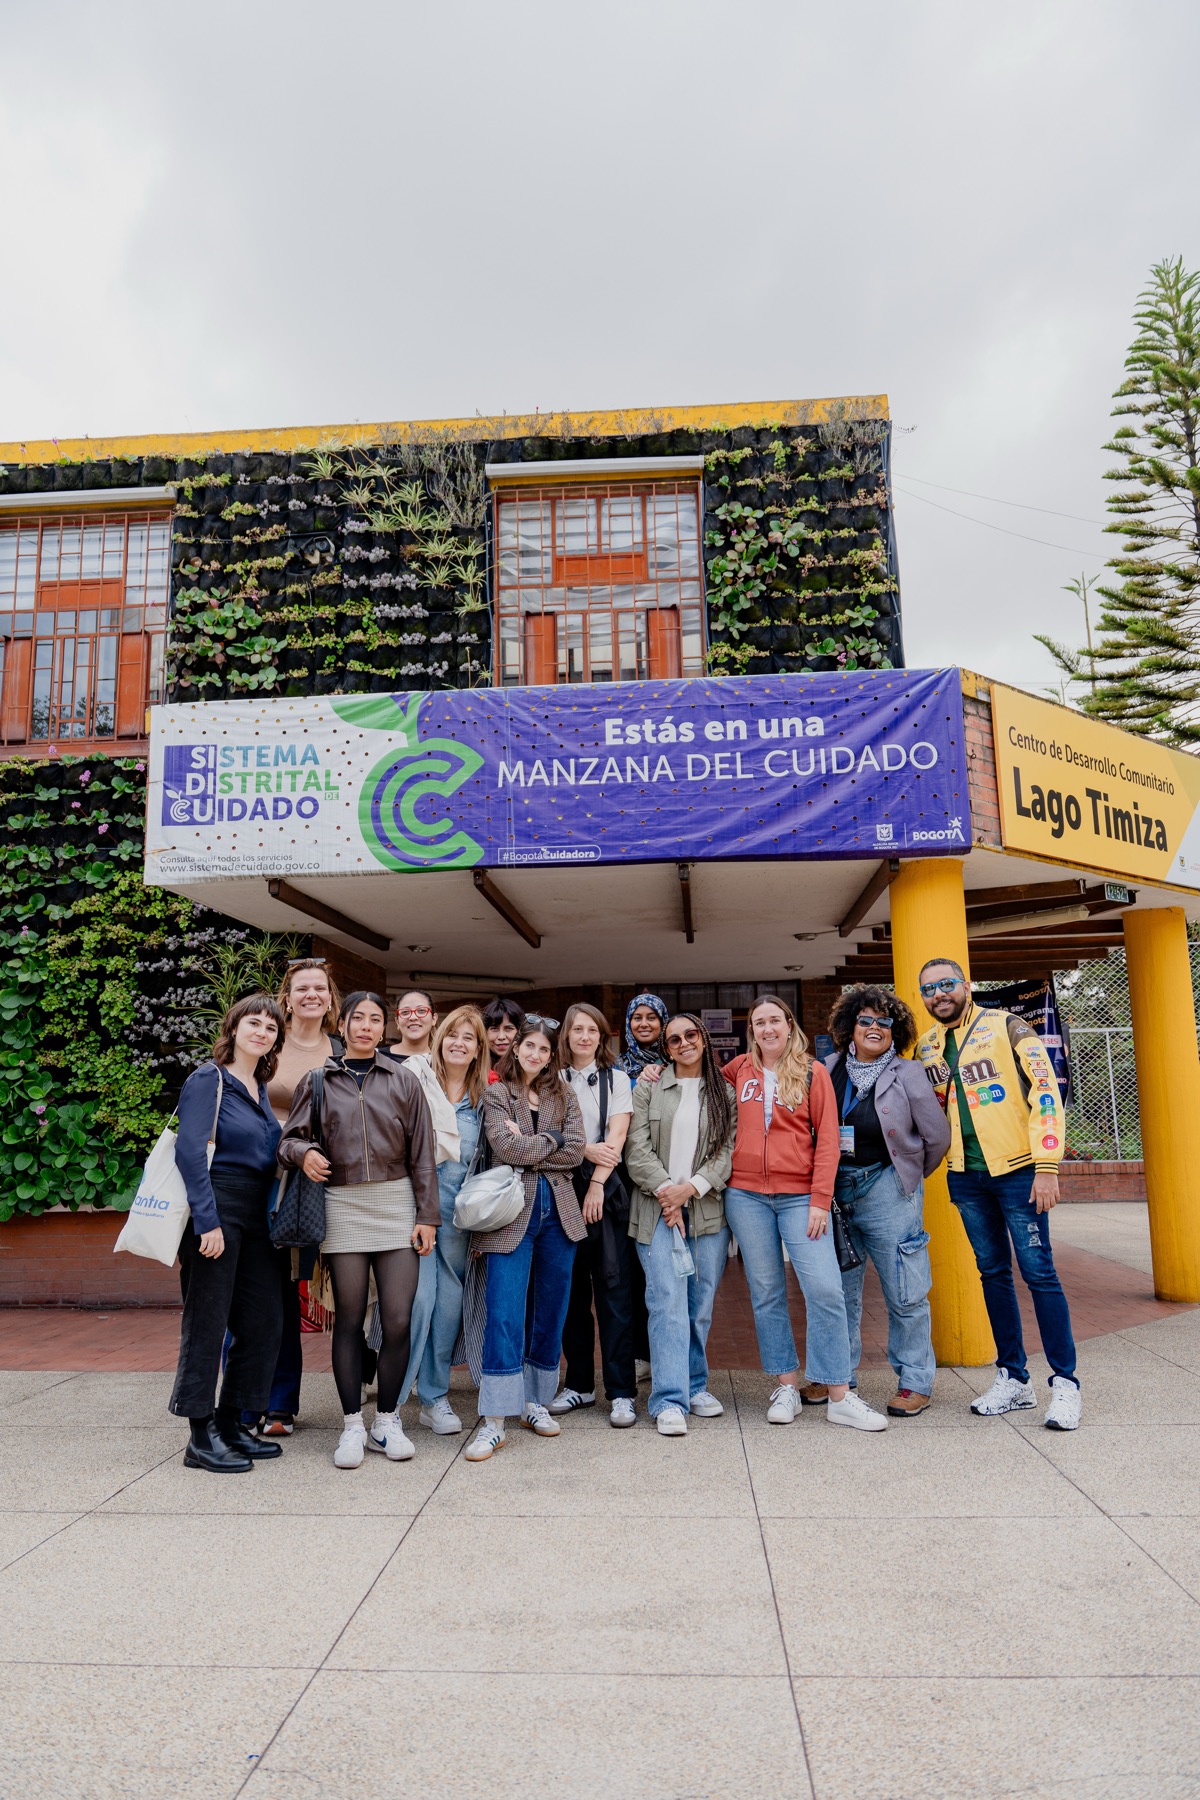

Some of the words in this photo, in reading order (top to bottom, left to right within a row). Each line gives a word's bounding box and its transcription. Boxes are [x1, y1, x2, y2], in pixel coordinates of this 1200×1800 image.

[604, 716, 695, 746] Estás
[704, 720, 748, 741] en
[757, 716, 825, 740] una
[190, 743, 321, 770] SISTEMA
[497, 755, 676, 789] MANZANA
[687, 752, 754, 782] DEL
[764, 741, 939, 778] CUIDADO
[1008, 725, 1047, 756] Centro
[1049, 740, 1063, 761] de
[1065, 744, 1117, 778] Desarrollo
[1119, 762, 1175, 796] Comunitario
[186, 769, 340, 796] DISTRITAL
[326, 792, 338, 800] DE
[170, 796, 320, 823] CUIDADO
[1012, 766, 1082, 839] Lago
[1085, 787, 1168, 853] Timiza
[159, 861, 320, 873] www.sistemadecuidado.gov.co
[160, 855, 196, 864] Consulta
[217, 854, 241, 862] todos
[242, 854, 255, 862] los
[256, 853, 293, 862] servicios
[1010, 1004, 1025, 1012] ser
[1020, 1007, 1054, 1019] rograma
[1028, 1016, 1047, 1028] gotá
[135, 1195, 170, 1210] antia
